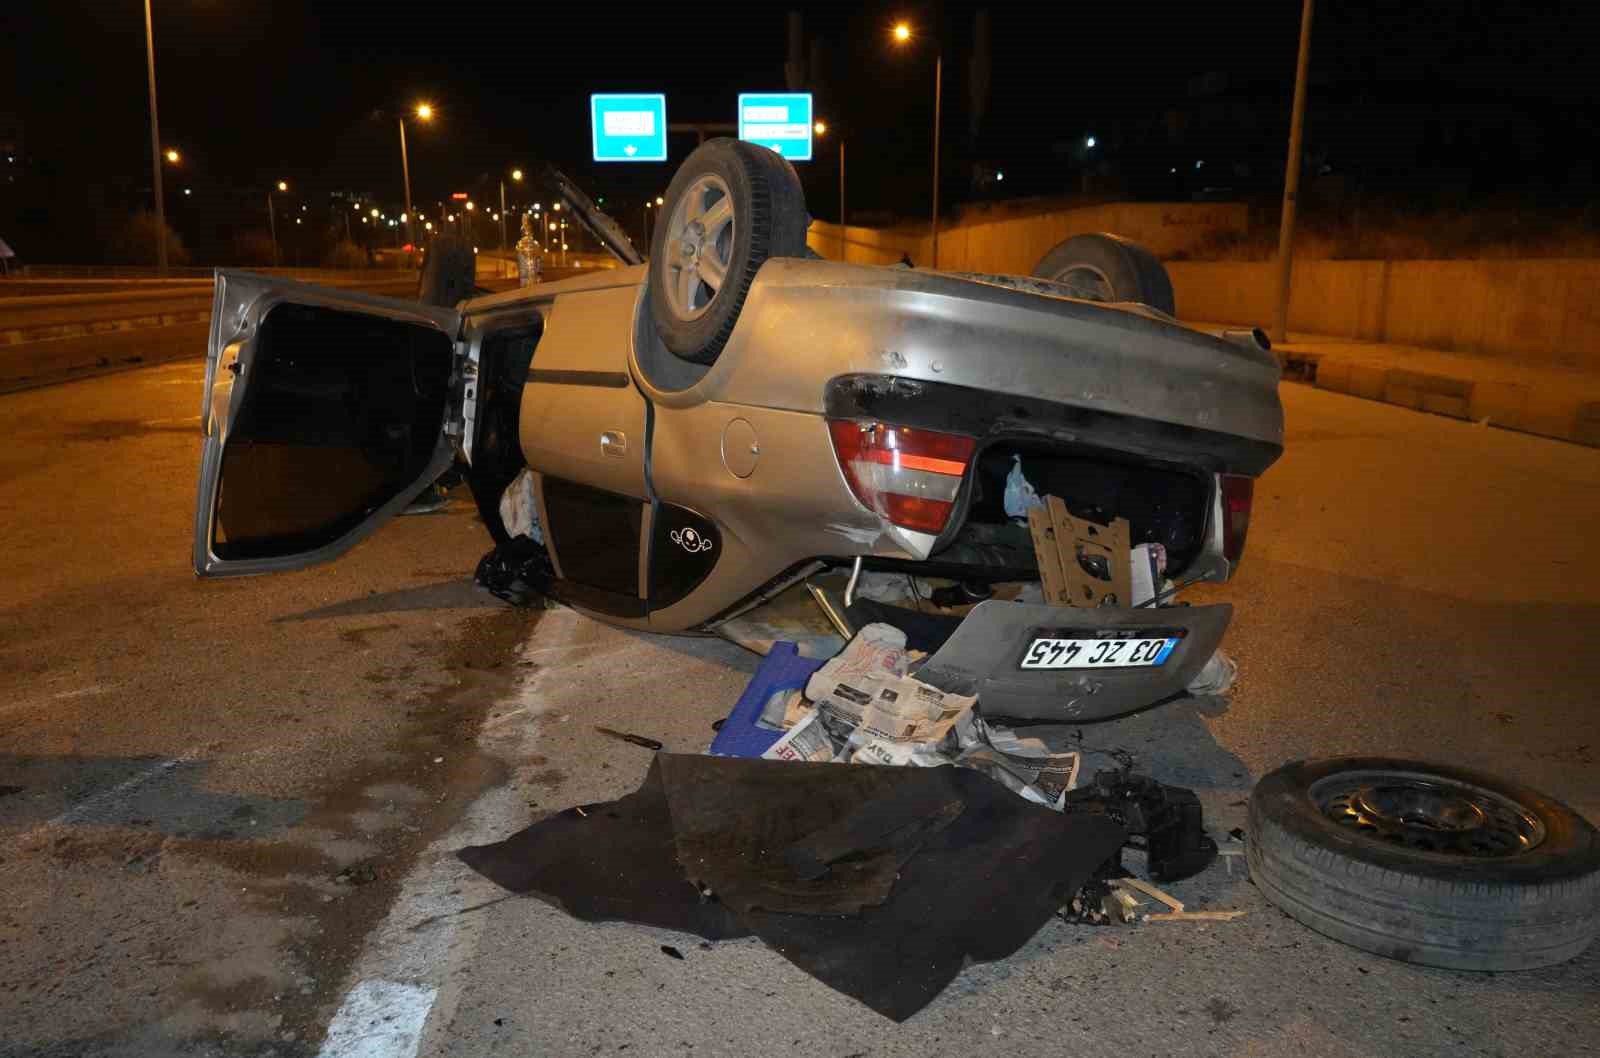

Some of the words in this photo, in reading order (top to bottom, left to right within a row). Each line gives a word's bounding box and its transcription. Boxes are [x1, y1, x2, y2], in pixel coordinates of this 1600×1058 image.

[1027, 641, 1081, 664] 445
[1088, 641, 1127, 663] ZC
[1128, 640, 1164, 662] 03
